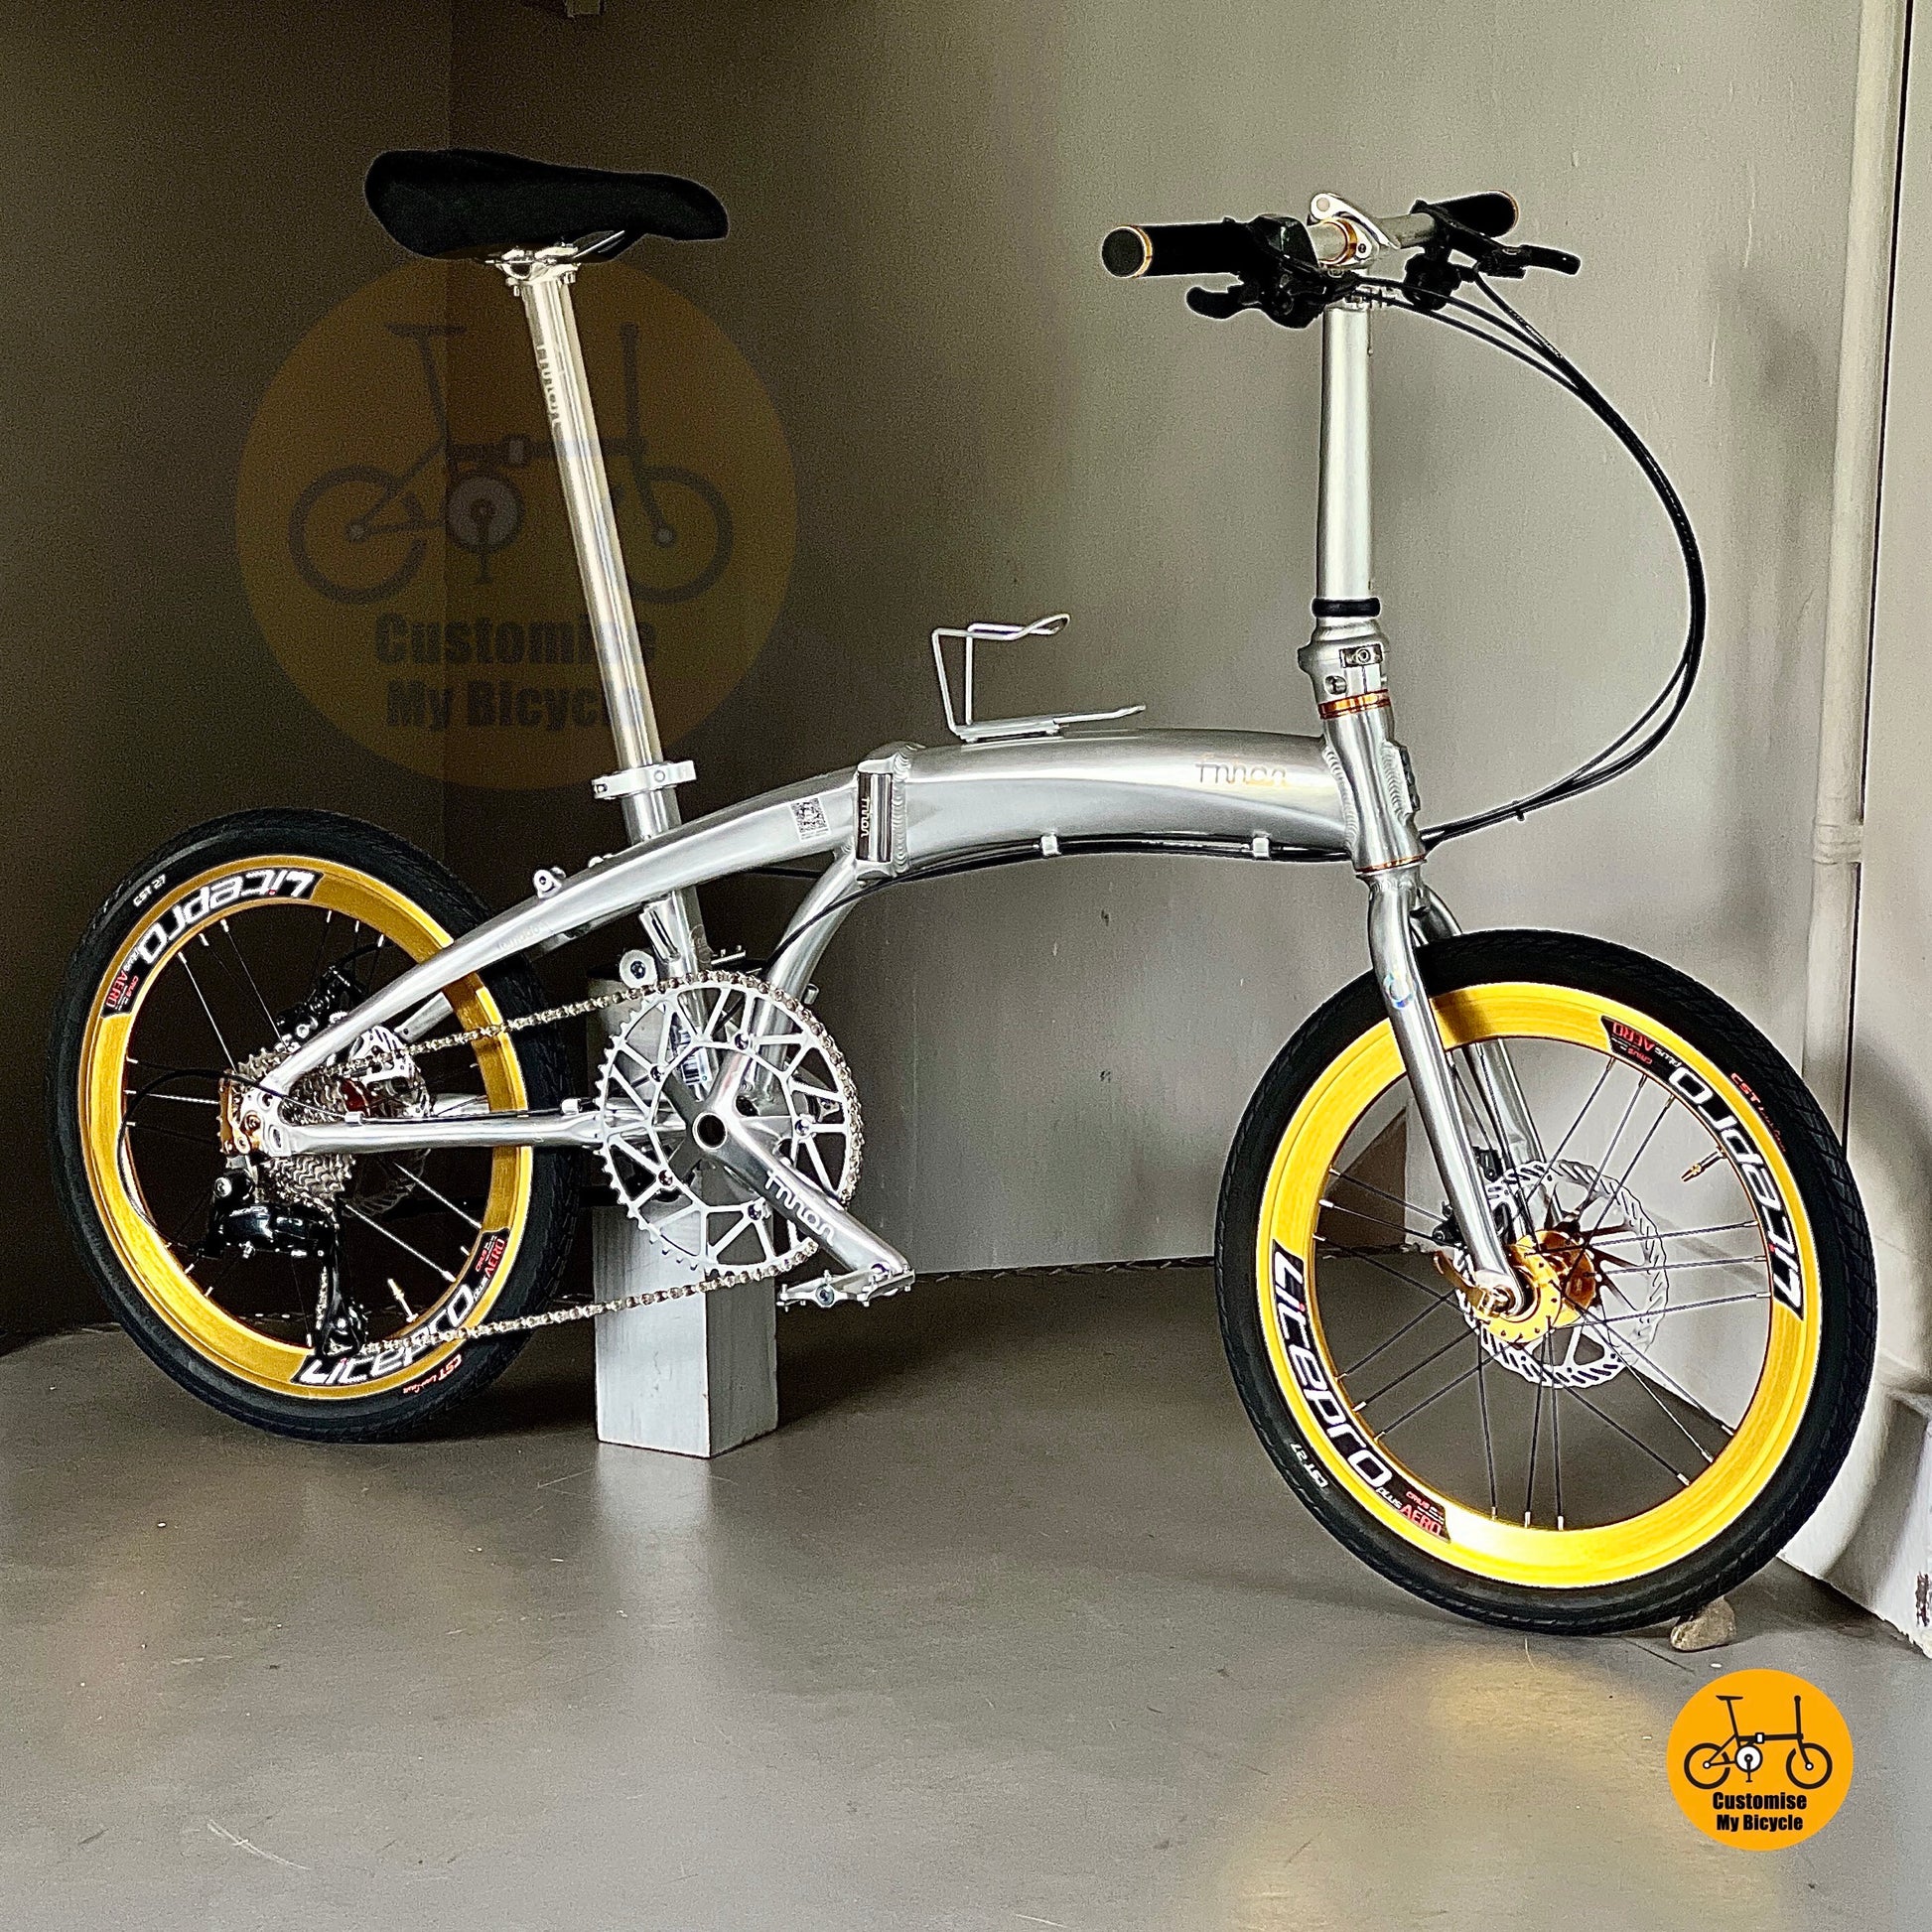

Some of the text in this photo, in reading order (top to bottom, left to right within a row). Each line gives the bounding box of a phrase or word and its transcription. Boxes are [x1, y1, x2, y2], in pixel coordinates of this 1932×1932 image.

[133, 885, 152, 907] CST
[106, 970, 128, 1009] AERO
[1612, 1021, 1655, 1052] AERO
[1730, 1072, 1761, 1104] CST
[484, 1238, 505, 1278] AERO
[438, 1353, 463, 1377] CST
[1290, 1442, 1329, 1489] CST 27
[1398, 1503, 1442, 1536] AERO
